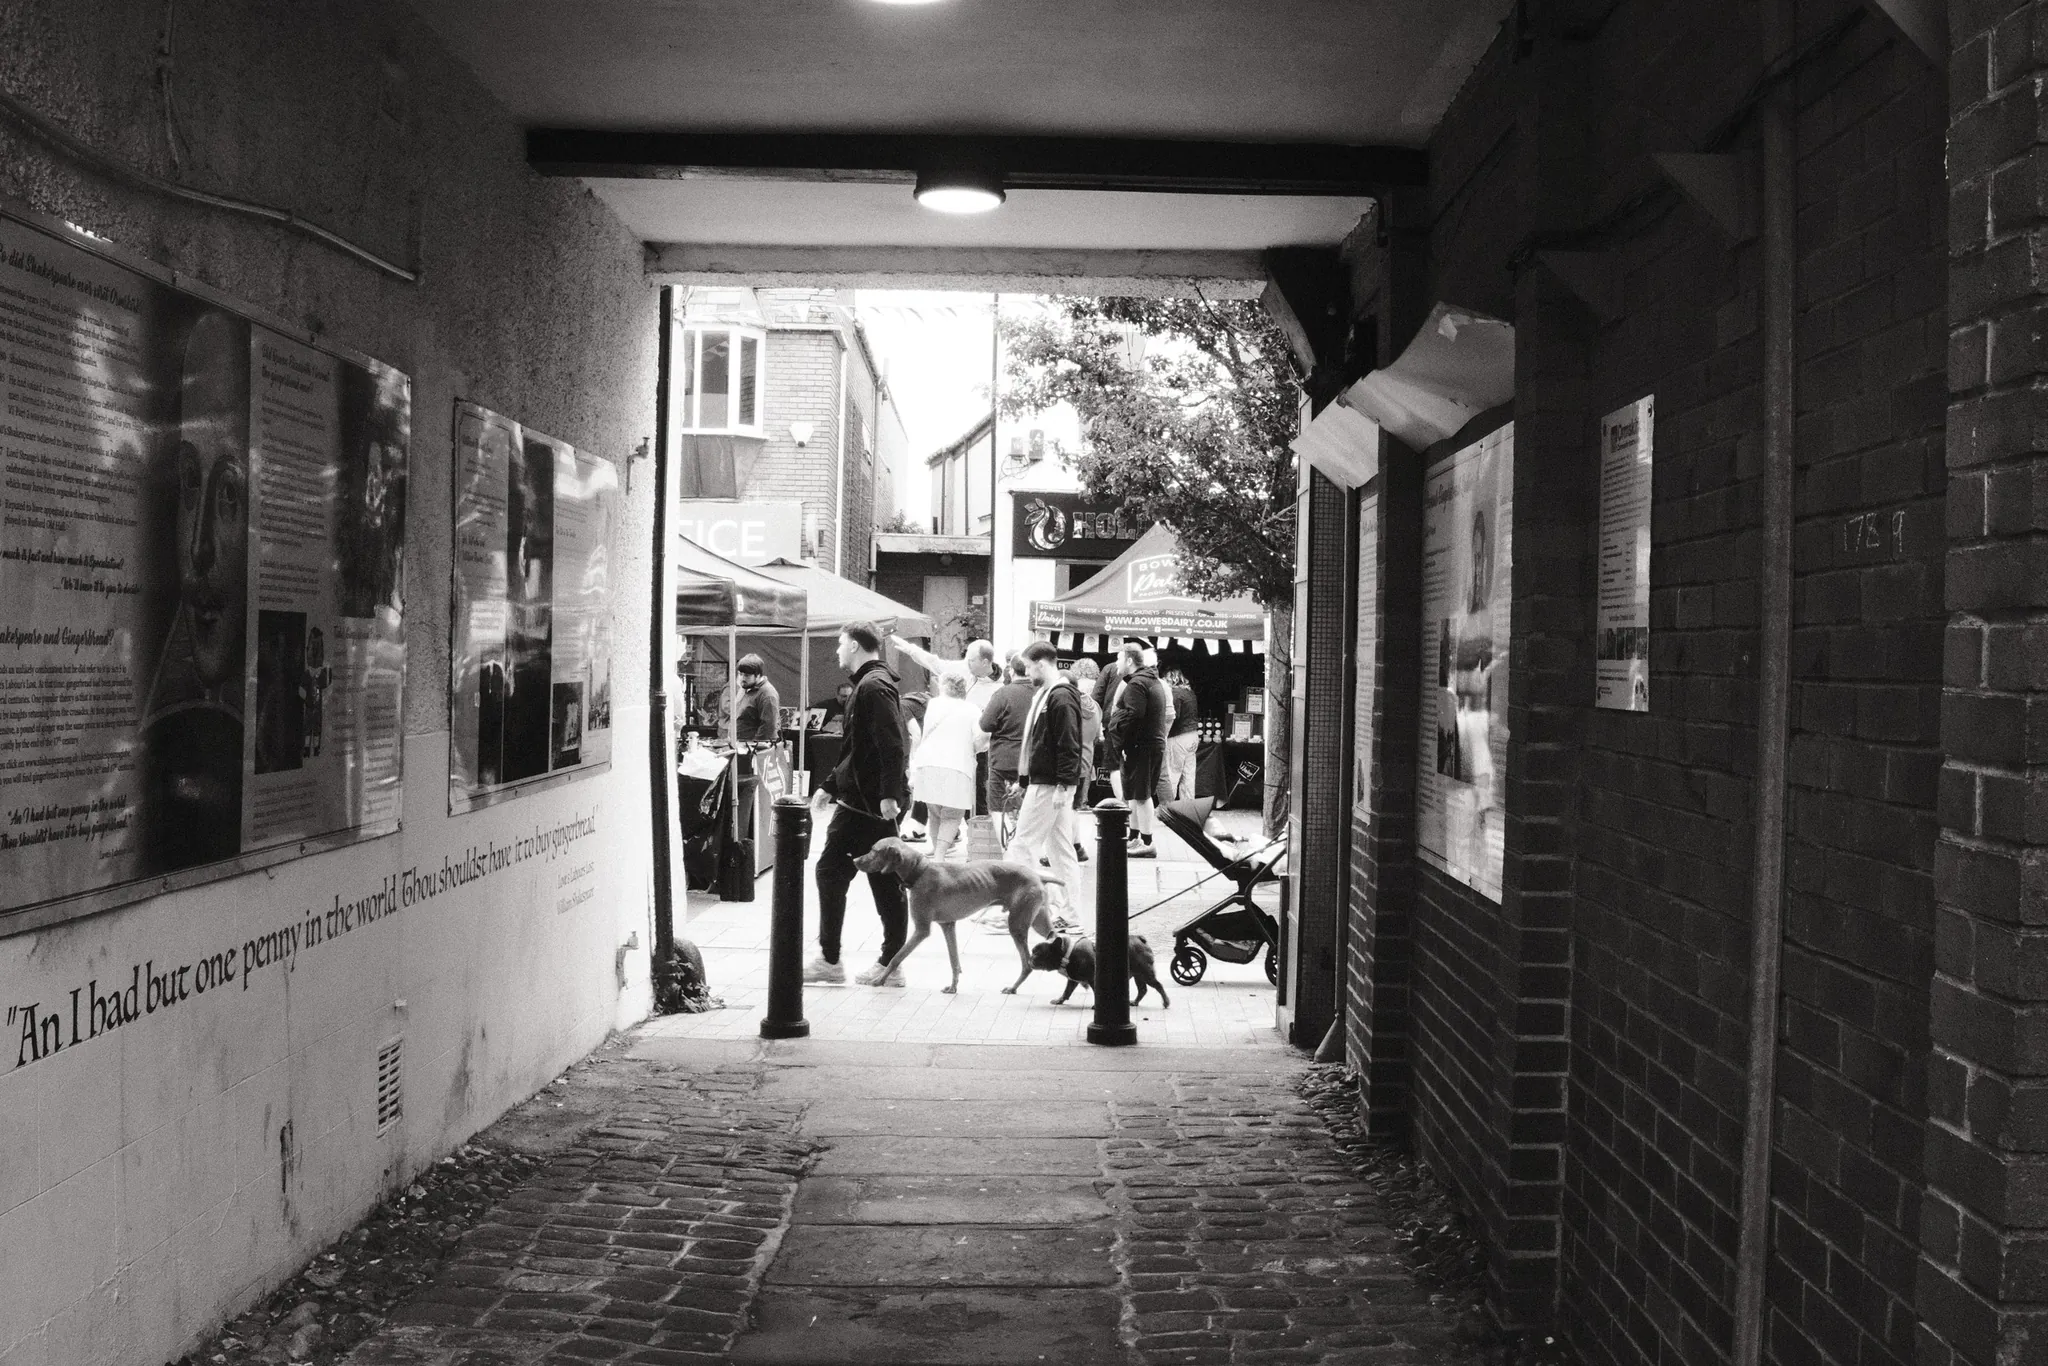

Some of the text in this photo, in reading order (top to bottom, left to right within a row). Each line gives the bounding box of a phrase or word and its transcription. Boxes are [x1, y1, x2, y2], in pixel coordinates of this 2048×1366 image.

[1165, 609, 1195, 617] PRESERVES
[1105, 615, 1228, 629] WWW.BOWESDAIRY.CO.UK
[42, 627, 61, 645] and
[69, 987, 83, 1047] I
[89, 964, 141, 1039] had
[145, 960, 192, 1014] but
[194, 947, 237, 994] one
[242, 922, 302, 991] penny
[304, 909, 323, 949] in
[325, 894, 353, 941] the
[354, 873, 397, 925] world
[400, 866, 437, 907] Thou
[438, 845, 488, 892] shouldst
[488, 841, 512, 874] have
[524, 837, 535, 860] to
[535, 824, 552, 863] buy
